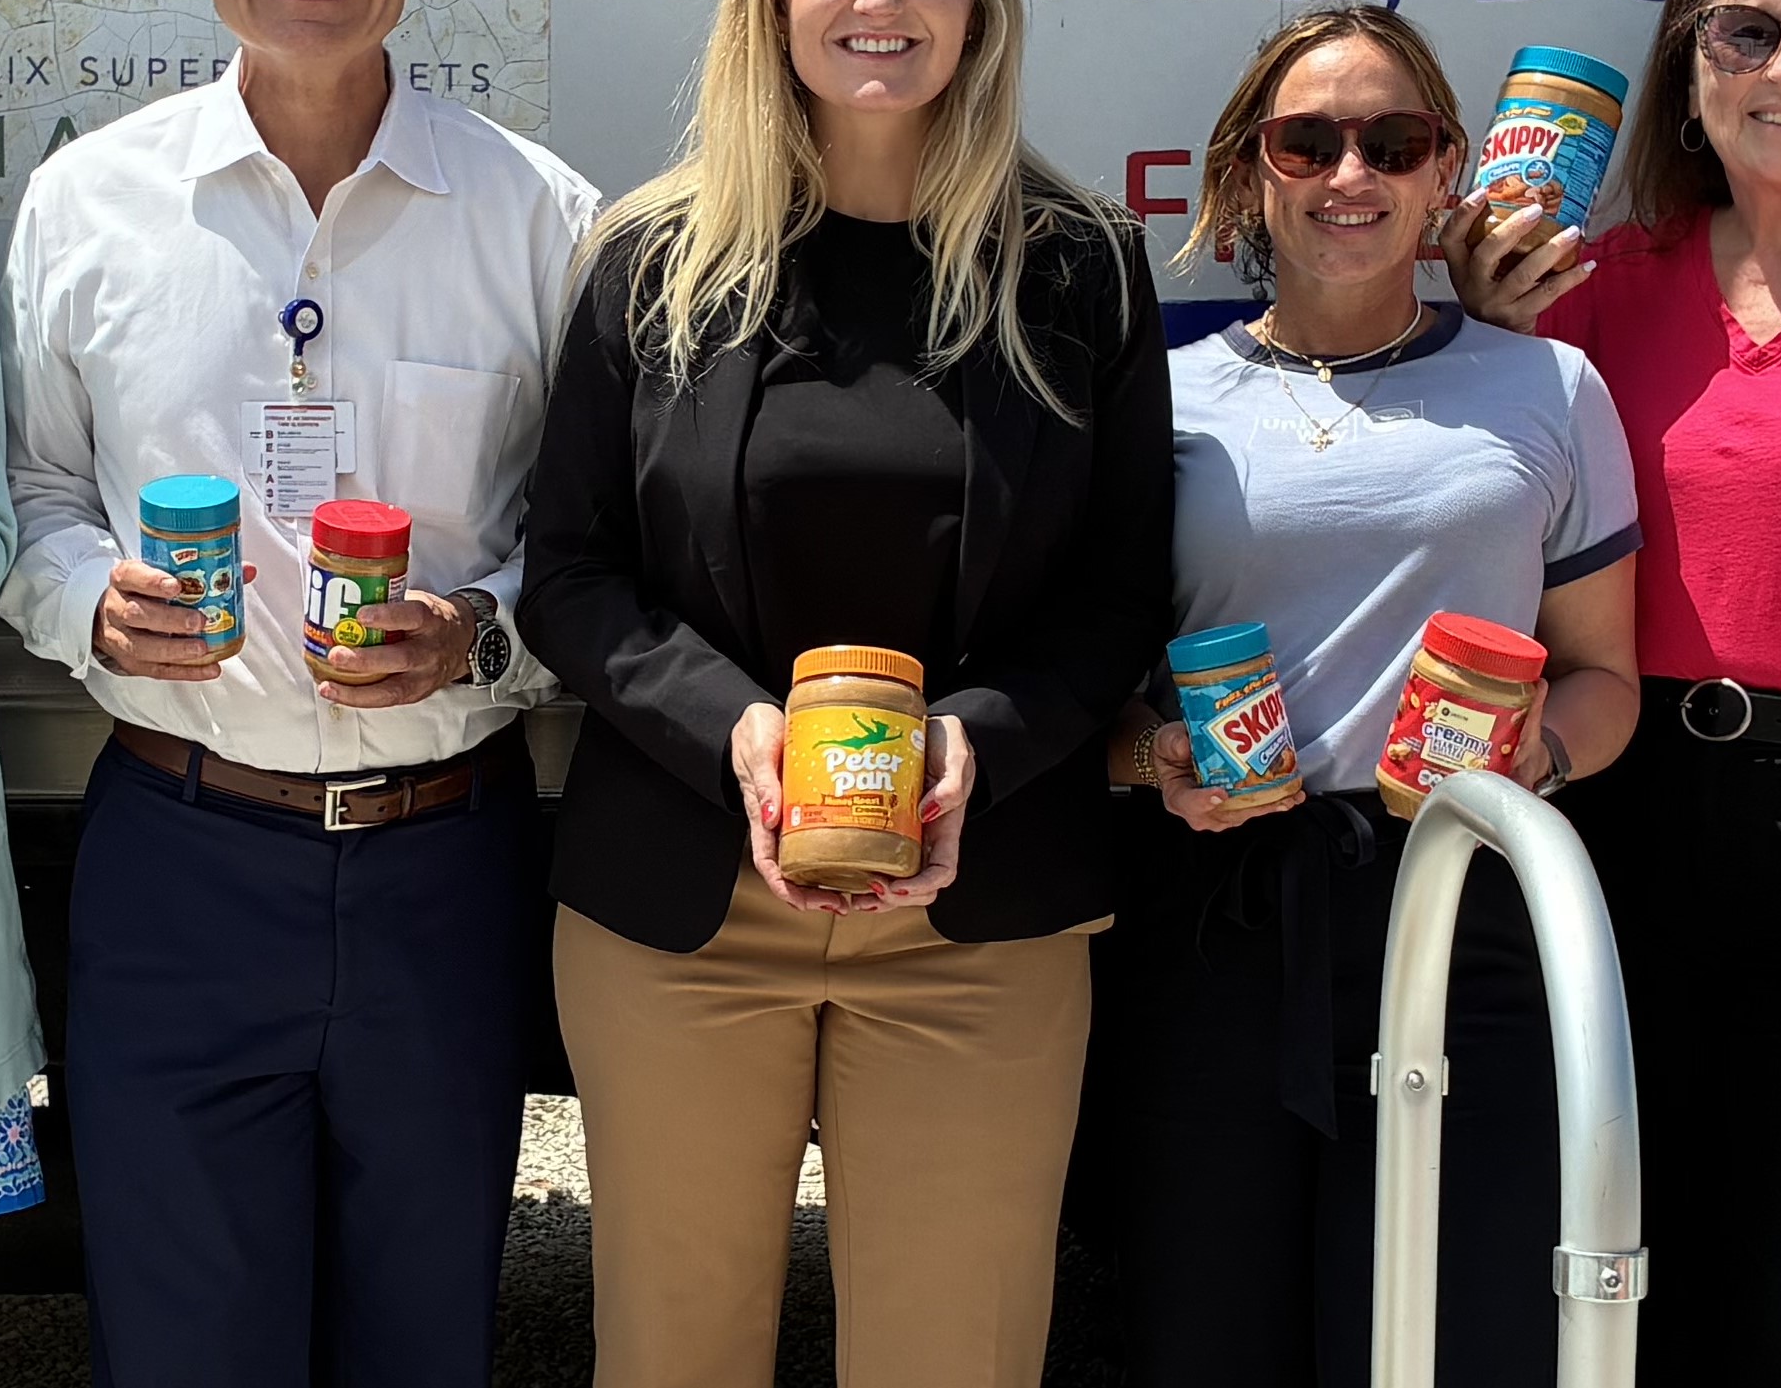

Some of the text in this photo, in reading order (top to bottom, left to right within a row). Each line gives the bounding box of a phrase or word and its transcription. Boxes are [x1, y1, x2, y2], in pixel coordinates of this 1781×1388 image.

[1480, 125, 1560, 167] SKIPPY
[1423, 722, 1491, 756] creamy
[822, 747, 905, 774] Peter
[830, 770, 895, 797] Pan
